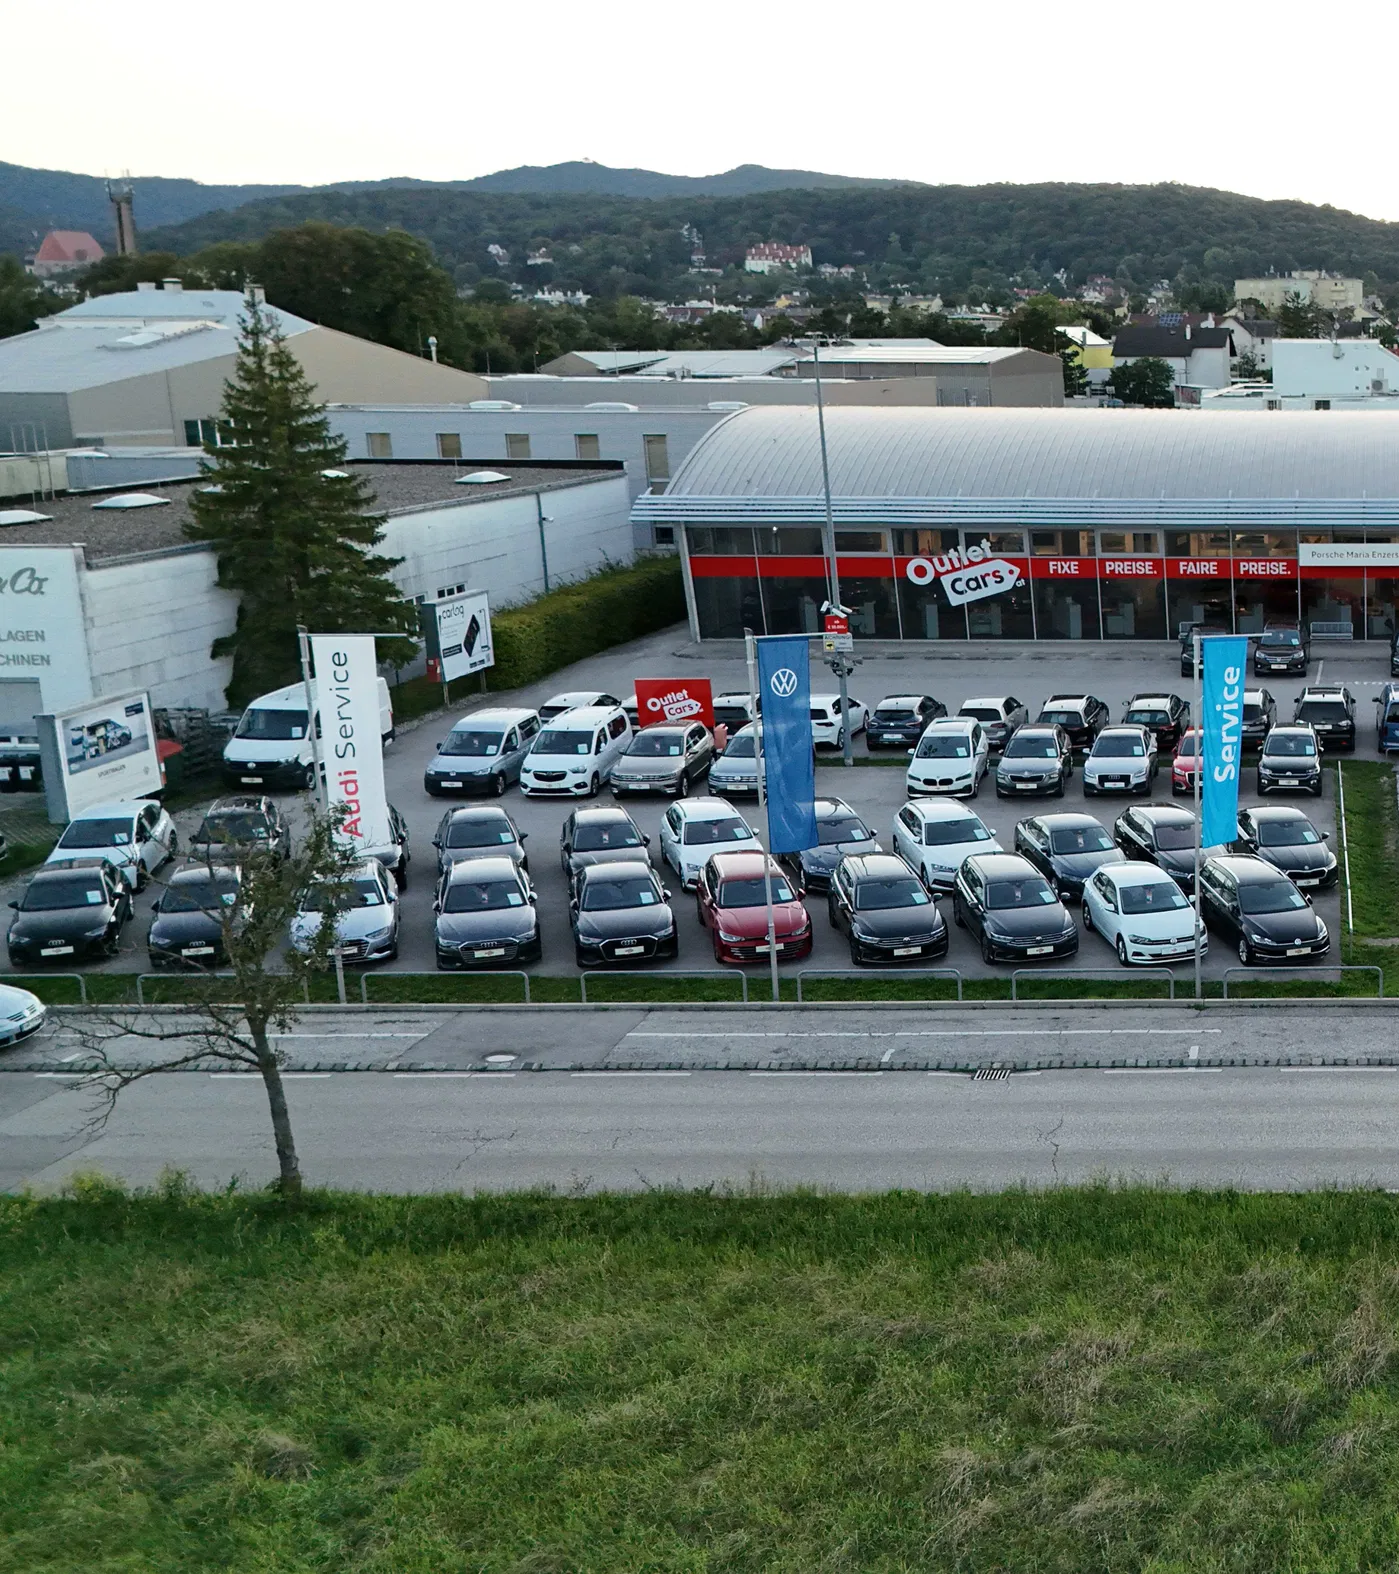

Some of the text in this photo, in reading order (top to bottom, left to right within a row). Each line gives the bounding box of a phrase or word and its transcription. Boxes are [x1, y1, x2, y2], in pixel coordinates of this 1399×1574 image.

[906, 538, 993, 585] Outlet
[1311, 551, 1345, 559] Porsche
[1346, 551, 1370, 559] Maria
[1049, 561, 1291, 575] FIXE PREISE. FAIRE PREISE.
[950, 569, 1005, 595] Cars
[646, 689, 689, 711] Outlet
[667, 703, 694, 716] Cars
[1213, 666, 1240, 783] Service
[329, 651, 363, 838] Audi Service
